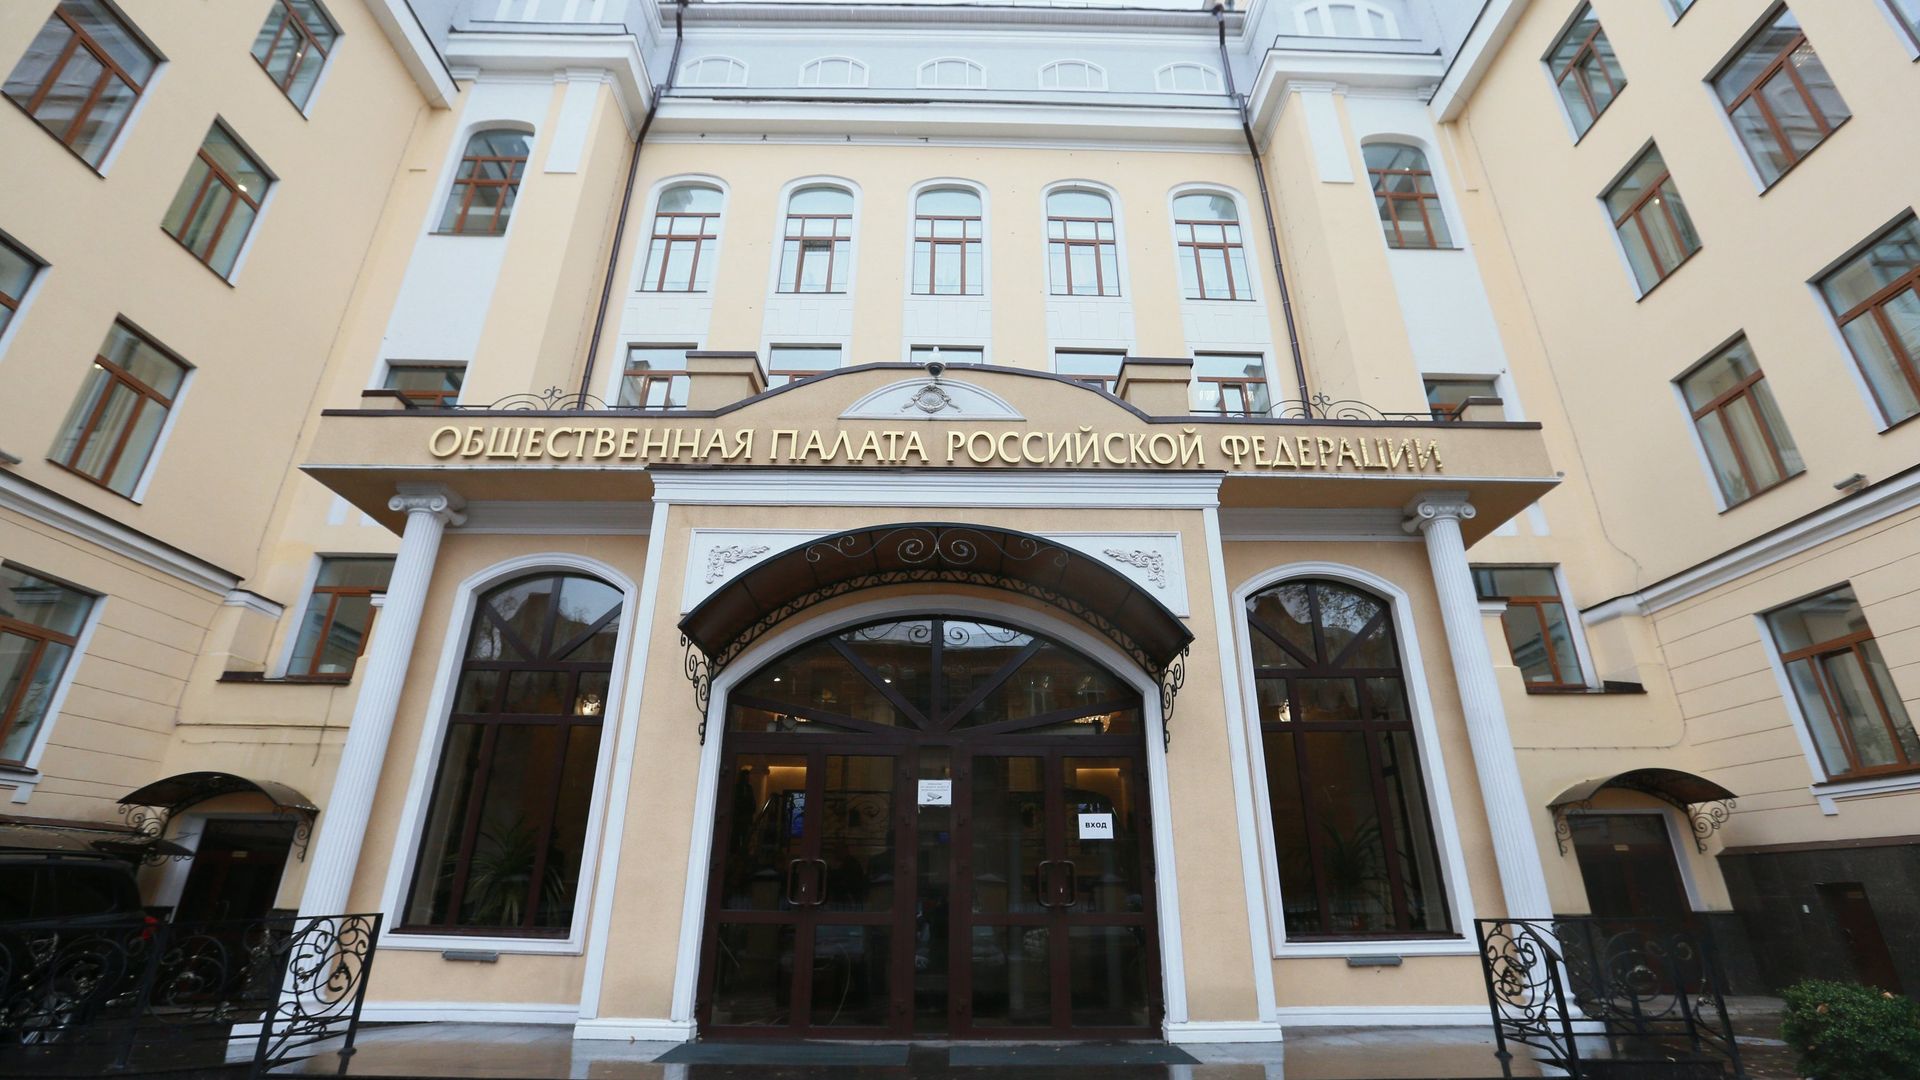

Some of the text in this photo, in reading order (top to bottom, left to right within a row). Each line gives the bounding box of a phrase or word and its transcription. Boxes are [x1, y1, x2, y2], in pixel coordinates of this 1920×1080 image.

[429, 425, 1444, 471] ОБЩЕСТВЕННАЯ ПАЛАТА РОССИЙСКОЙ ФЕДЕРАЦИИ
